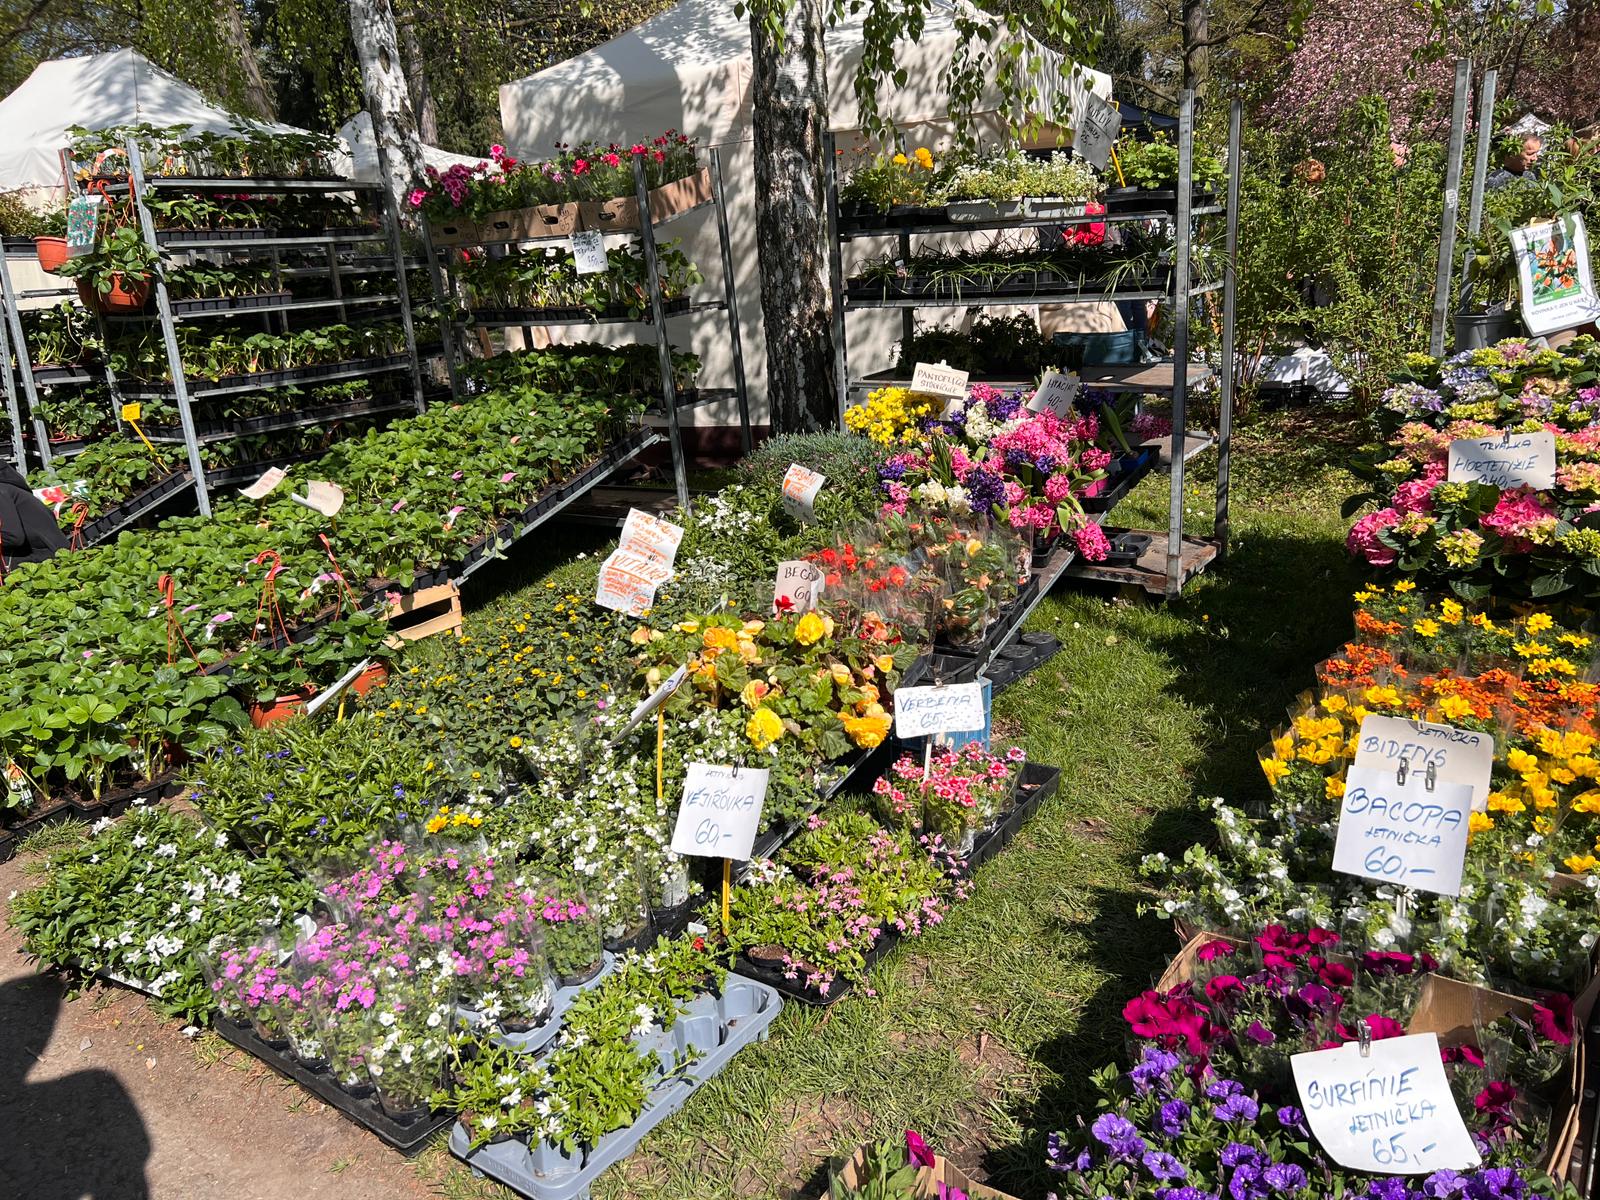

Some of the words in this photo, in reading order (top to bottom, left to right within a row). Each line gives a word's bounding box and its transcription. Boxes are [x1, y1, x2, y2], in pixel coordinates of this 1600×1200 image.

[1345, 787, 1462, 830] BACOPA
[1364, 845, 1436, 878] 60,-
[1307, 1067, 1419, 1110] SURFÍNIE
[1372, 1131, 1437, 1165] 65,-
